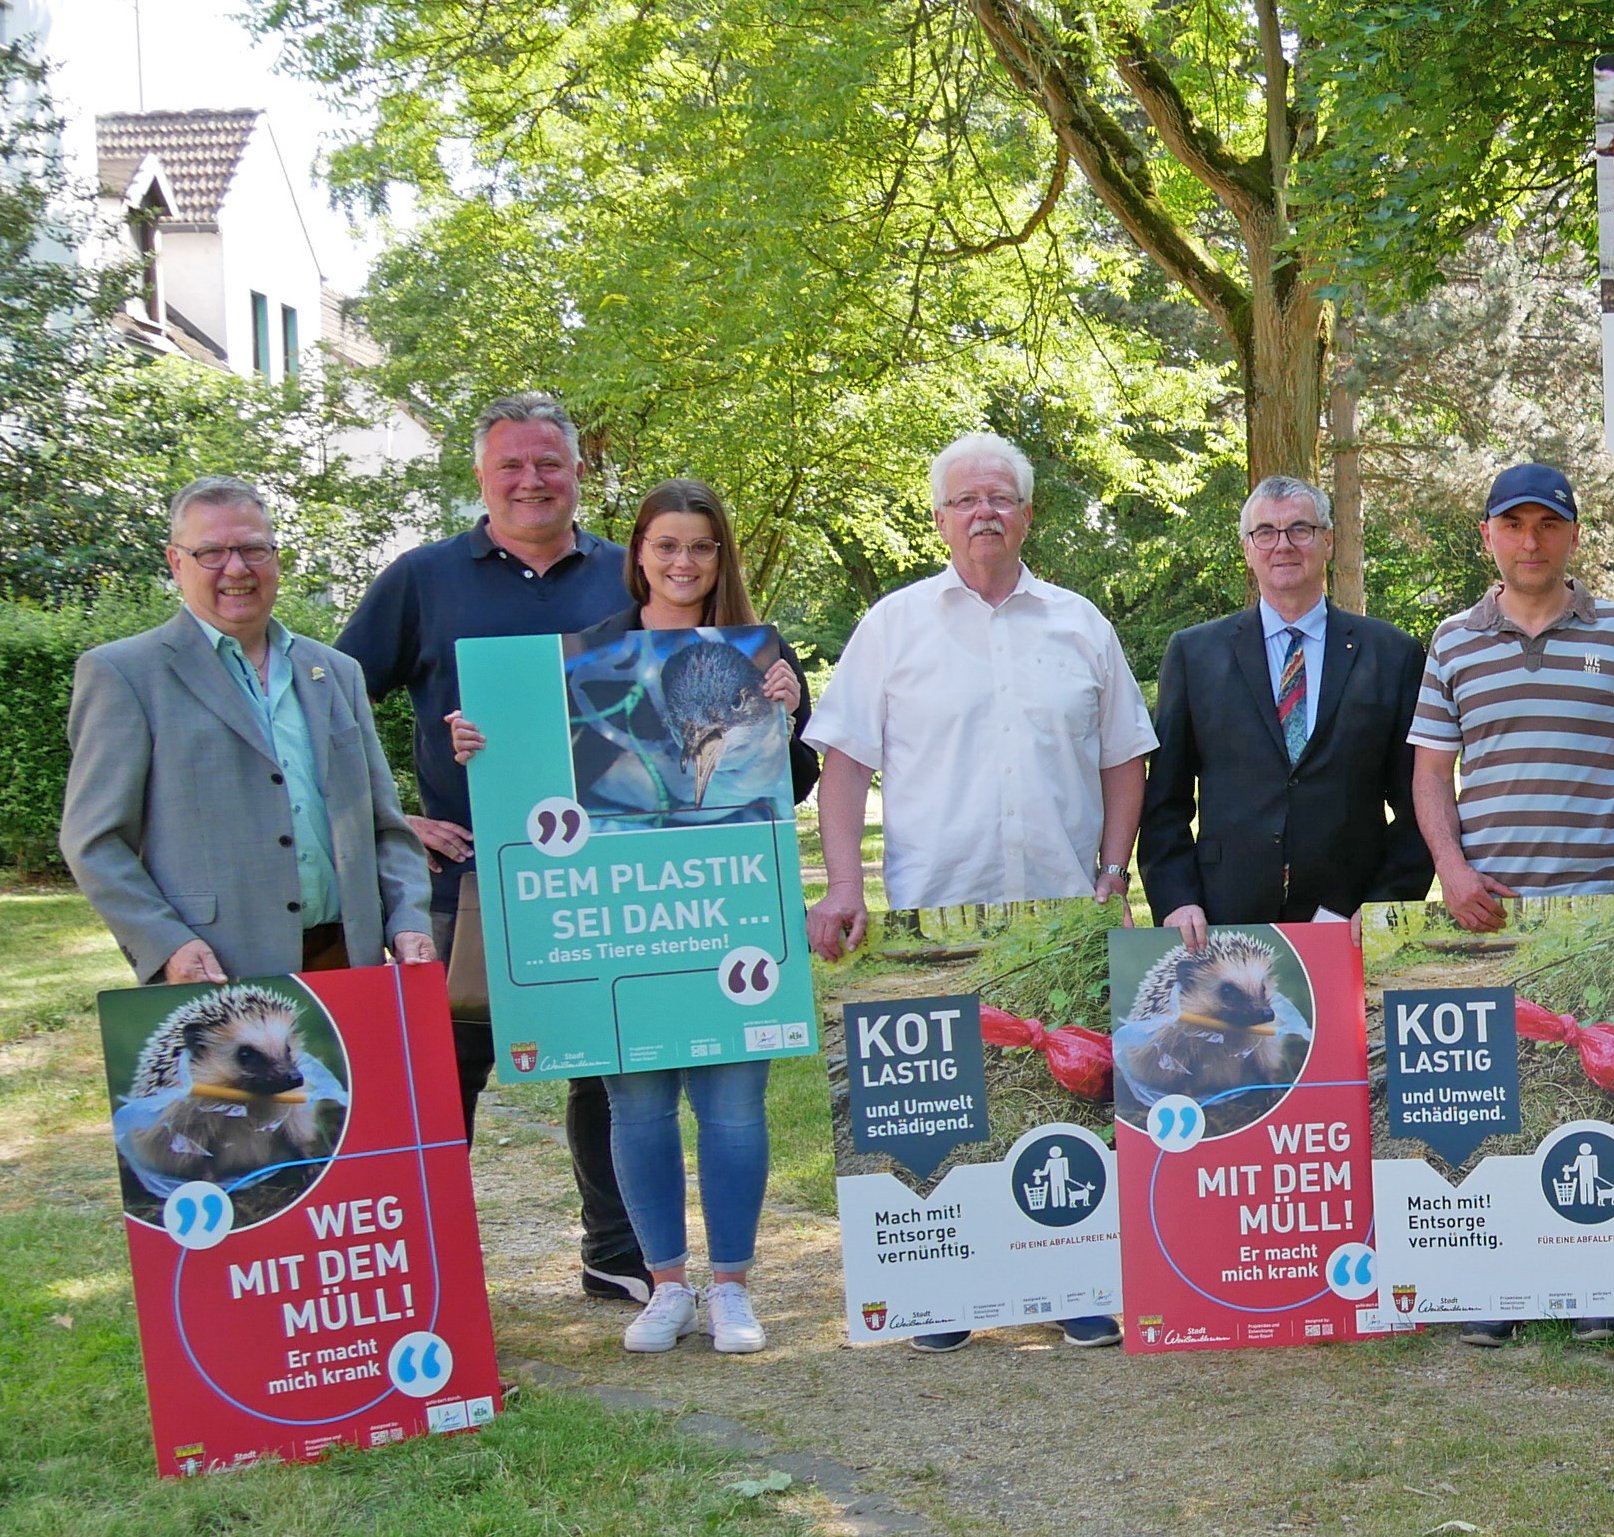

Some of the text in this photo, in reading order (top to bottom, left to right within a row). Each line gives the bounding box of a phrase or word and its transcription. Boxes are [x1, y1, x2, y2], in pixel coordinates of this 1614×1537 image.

[518, 854, 767, 900] DEM PLASTIK
[553, 907, 610, 938] SEI
[624, 898, 728, 933] DANK
[549, 948, 592, 962] dass
[596, 943, 645, 958] Tiere
[652, 934, 728, 954] sterben!
[858, 1010, 960, 1058] KOT
[1398, 1002, 1496, 1045] KOT
[564, 1052, 584, 1060] Stadt
[1400, 1050, 1491, 1073] LASTIG
[863, 1058, 957, 1086] LASTIG
[866, 1095, 973, 1118] und Umwelt
[1403, 1086, 1505, 1104] und Umwelt
[868, 1114, 973, 1137] schädigend.
[1404, 1106, 1505, 1124] schädigend.
[1268, 1122, 1350, 1154] WEG
[1198, 1161, 1350, 1197] MIT DEM
[1408, 1195, 1490, 1210] Mach mit!
[307, 1196, 402, 1239] WEG
[876, 1204, 960, 1226] Mach mit!
[1240, 1196, 1352, 1234] MÜLL!
[1409, 1216, 1485, 1231] Entsorge
[878, 1228, 956, 1244] Entsorge
[1010, 1241, 1025, 1251] FÜR
[1028, 1239, 1048, 1249] EINE
[1050, 1234, 1104, 1245] ABFALLFREIE
[1409, 1233, 1502, 1249] vernünftig.
[1538, 1236, 1554, 1244] FÜR
[1556, 1236, 1575, 1244] EINE
[878, 1244, 974, 1263] vernünftig.
[1241, 1244, 1317, 1261] Er macht
[230, 1240, 408, 1298] MIT DEM
[1222, 1262, 1318, 1282] mich krank
[283, 1284, 414, 1337] MÜLL!
[288, 1339, 377, 1368] Er macht
[269, 1360, 380, 1394] mich krank
